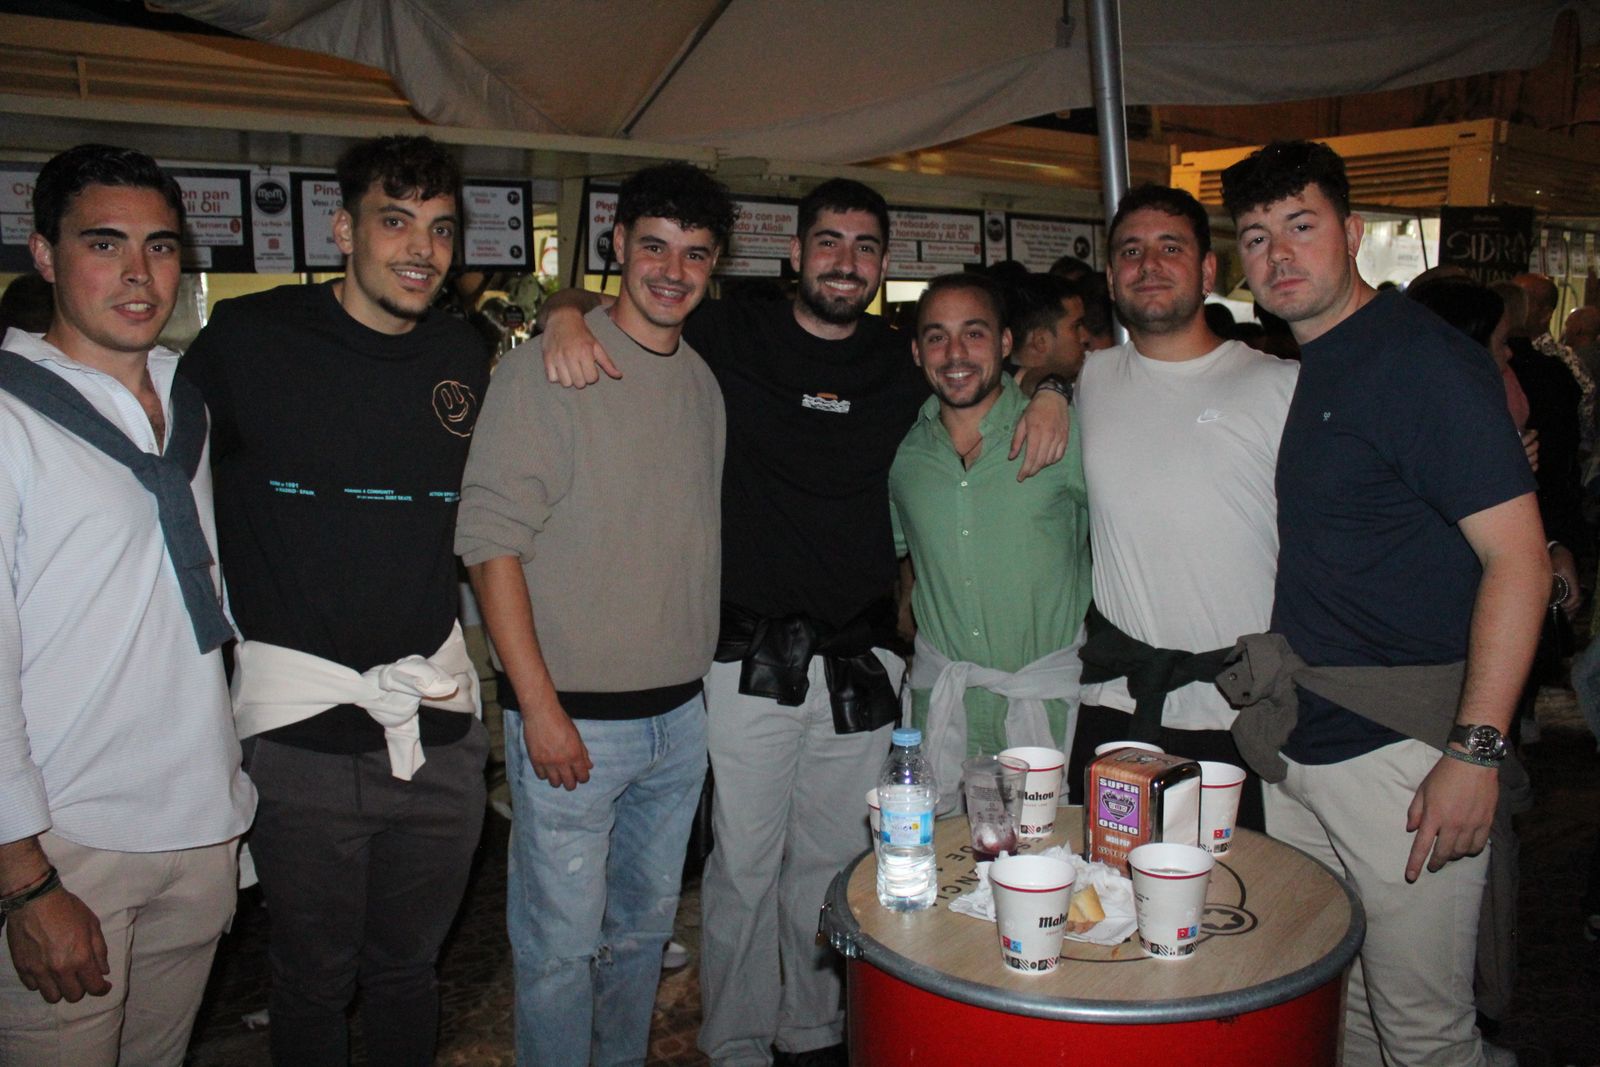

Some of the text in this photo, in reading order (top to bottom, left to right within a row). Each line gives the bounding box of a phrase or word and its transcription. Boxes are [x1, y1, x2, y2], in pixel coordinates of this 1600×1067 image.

[202, 190, 230, 204] pan
[200, 201, 221, 214] Oli
[774, 214, 793, 224] pan
[1099, 777, 1139, 795] SUPER
[1098, 818, 1138, 835] OCHO
